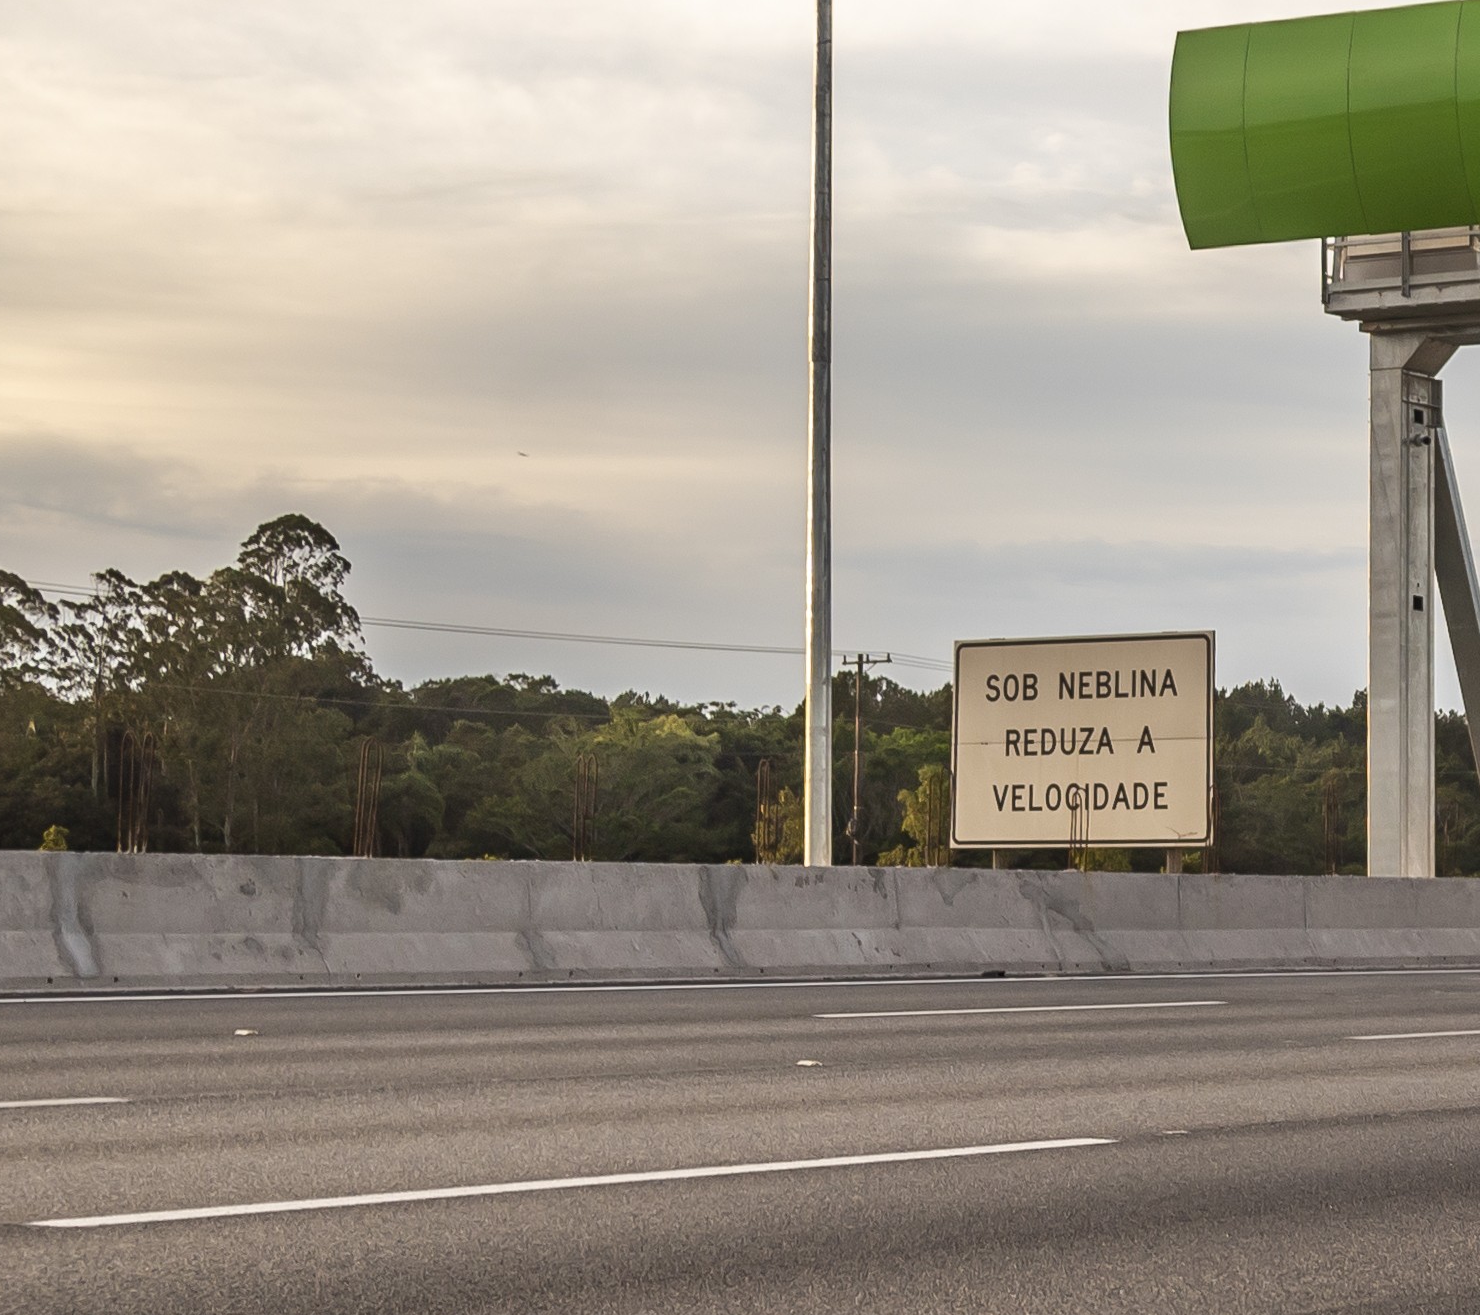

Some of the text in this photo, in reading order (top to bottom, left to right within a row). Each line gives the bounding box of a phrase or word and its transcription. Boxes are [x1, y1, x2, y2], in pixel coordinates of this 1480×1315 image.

[985, 668, 1178, 703] SOB NEBLINA
[1004, 725, 1156, 757] REDUZA A
[992, 781, 1169, 812] VELOCIDADE
